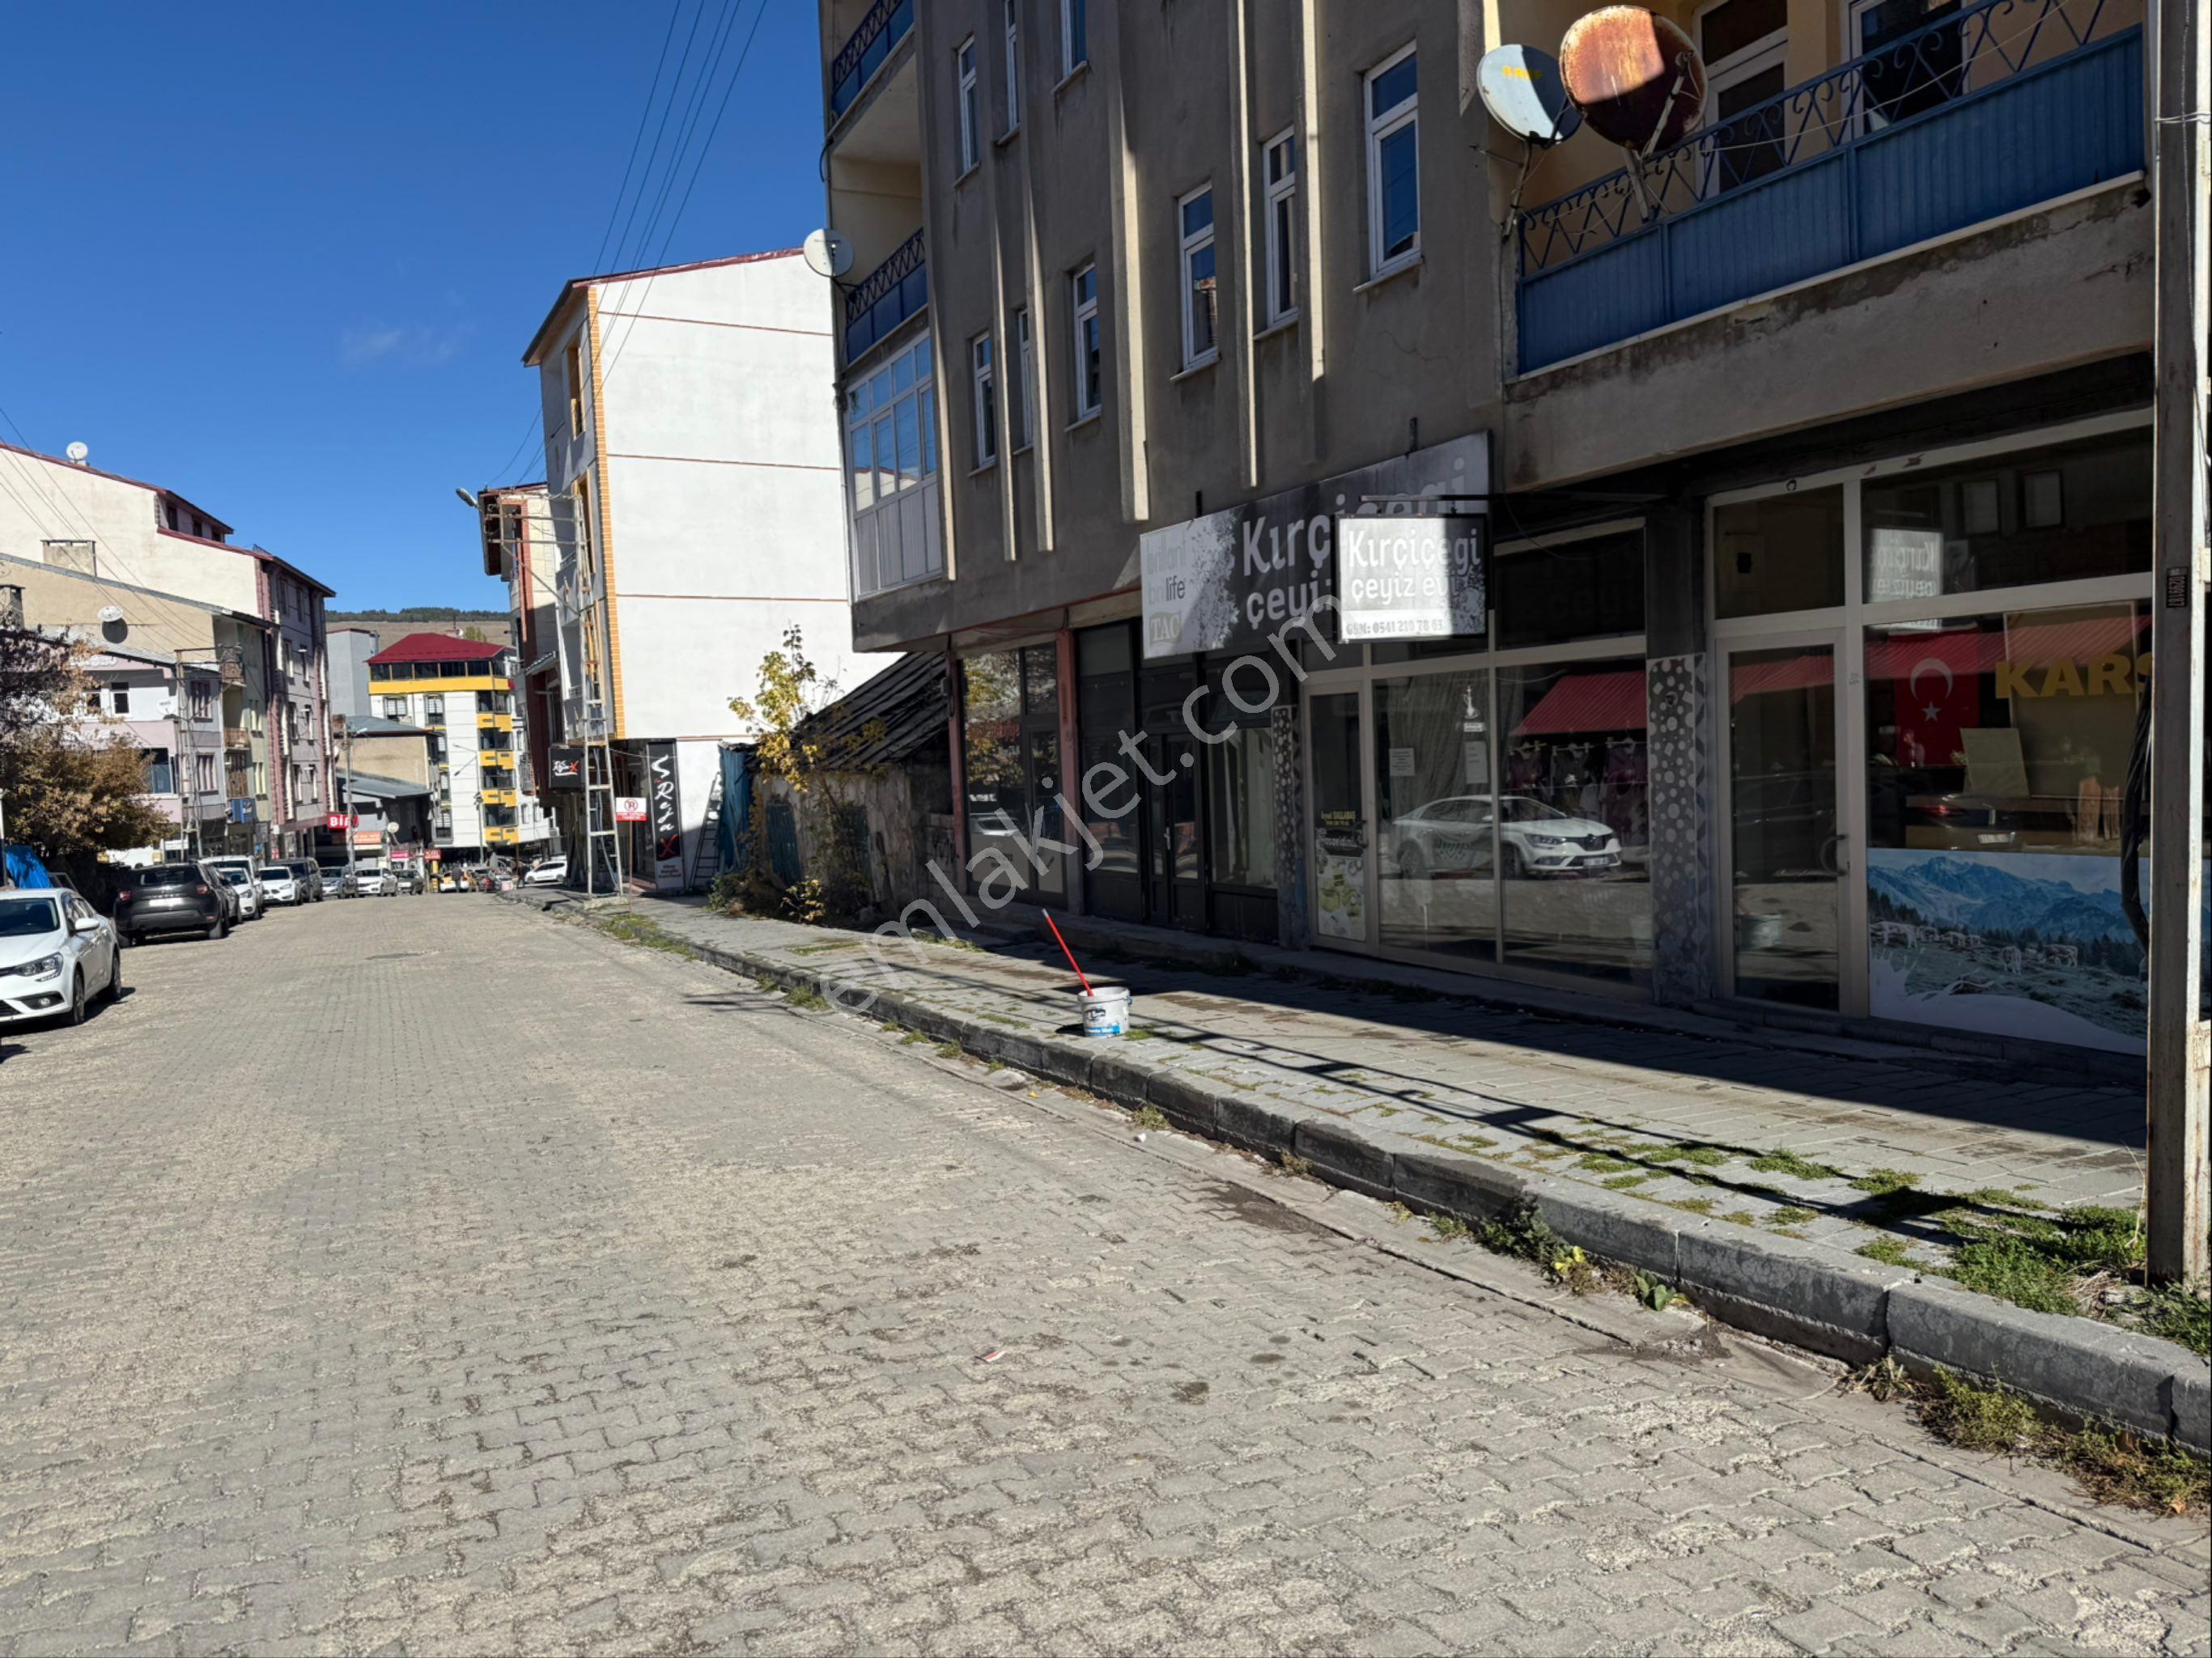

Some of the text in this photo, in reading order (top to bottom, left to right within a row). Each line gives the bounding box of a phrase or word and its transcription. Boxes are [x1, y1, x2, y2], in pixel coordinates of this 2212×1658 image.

[1246, 570, 1333, 630] çeyi
[1351, 570, 1460, 605] çeyiz evi
